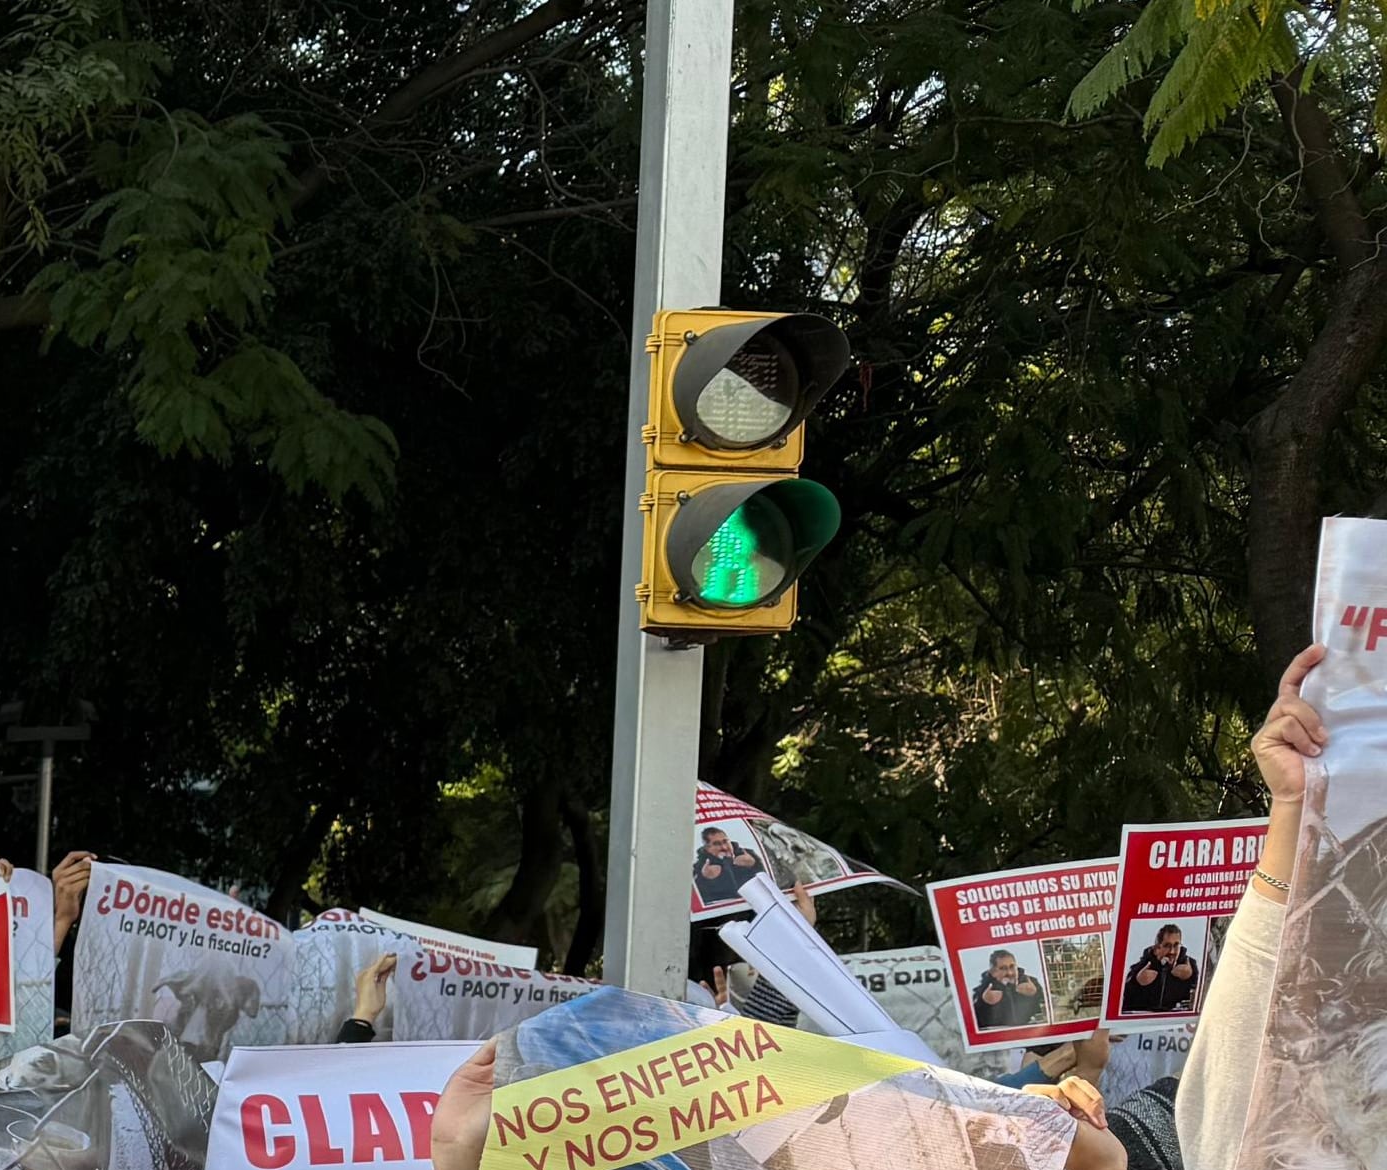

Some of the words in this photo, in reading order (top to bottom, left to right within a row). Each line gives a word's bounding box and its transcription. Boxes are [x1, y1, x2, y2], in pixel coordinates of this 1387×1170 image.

[1149, 837, 1225, 870] CLARA
[956, 876, 1059, 906] SOLICITAMOS
[1060, 874, 1081, 891] SU
[97, 879, 200, 925] ¿Dónde
[206, 907, 280, 941] están
[958, 907, 977, 925] EL
[978, 901, 1020, 921] CASO
[1022, 898, 1043, 915] DE
[1044, 889, 1113, 912] MALTRATO
[119, 914, 134, 933] la
[137, 919, 177, 941] PAOT
[178, 931, 189, 948] y
[190, 928, 204, 947] la
[990, 920, 1023, 939] más
[1025, 914, 1076, 936] grande
[1077, 911, 1095, 928] de
[440, 978, 456, 997] la
[462, 980, 511, 1000] PAOT
[513, 987, 524, 1005] y
[529, 984, 545, 1002] la
[1137, 1033, 1153, 1051] la
[1157, 1034, 1191, 1053] PAO
[492, 1087, 590, 1147] NOS
[596, 1022, 783, 1114] ENFERMA
[669, 1074, 784, 1141] MATA
